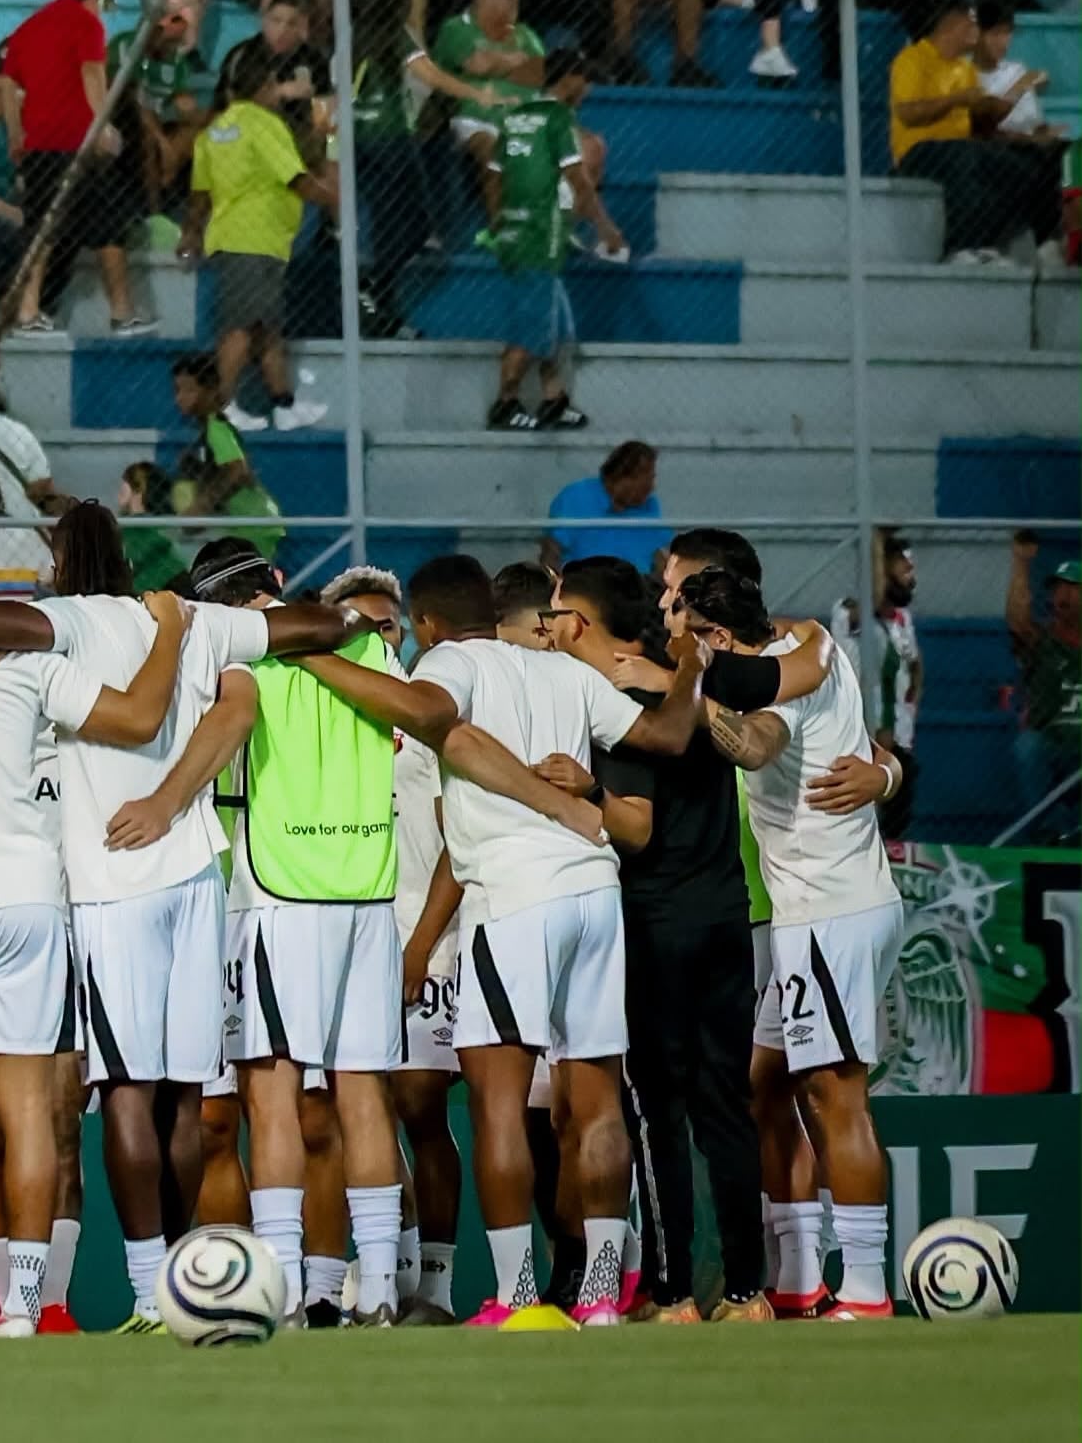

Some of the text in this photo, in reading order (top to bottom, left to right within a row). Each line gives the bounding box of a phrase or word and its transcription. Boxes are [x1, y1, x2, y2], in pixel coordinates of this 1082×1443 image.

[284, 822, 390, 838] Love for our gam
